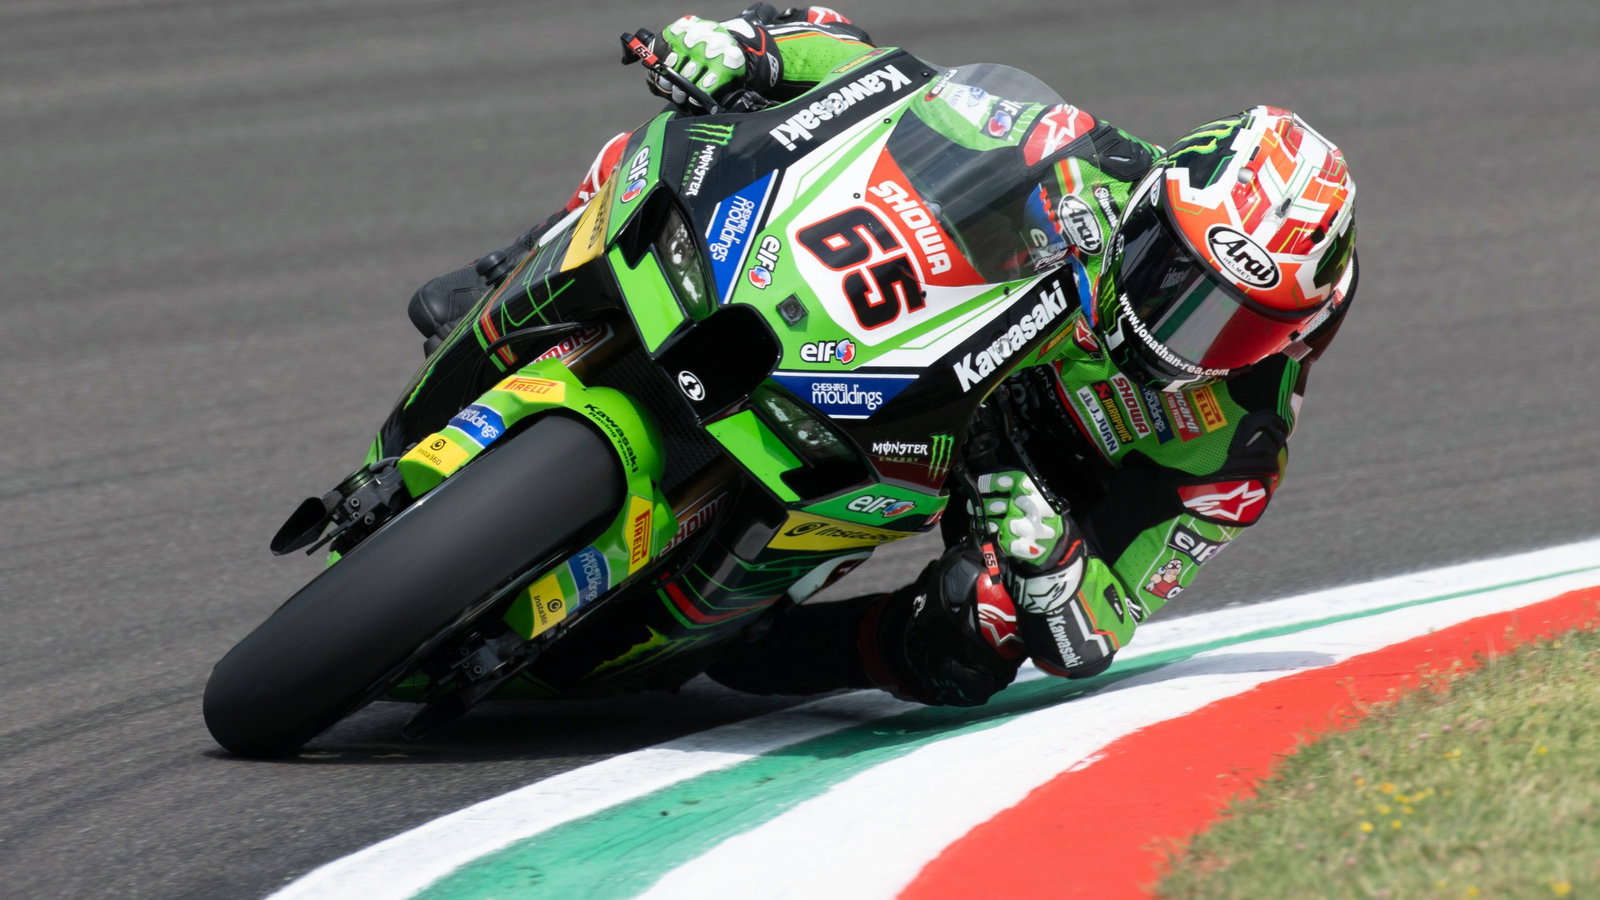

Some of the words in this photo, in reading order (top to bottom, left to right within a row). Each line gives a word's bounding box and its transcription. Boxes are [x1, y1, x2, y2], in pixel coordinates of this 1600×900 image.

[635, 46, 651, 58] 65
[769, 64, 912, 151] Kawasaki
[628, 147, 650, 182] elf
[681, 151, 699, 187] ENERGY
[686, 145, 716, 196] MONSTER
[709, 195, 748, 262] mouldings
[738, 200, 755, 233] CHESHIRE
[868, 180, 952, 275] SHOWA
[1063, 200, 1101, 249] Arai
[756, 235, 781, 272] elf
[795, 206, 927, 331] 65
[1209, 238, 1276, 281] Arai
[800, 342, 835, 363] elf
[953, 280, 1068, 393] Kawasaki
[1119, 293, 1230, 377] www.jonathan-rea.com
[503, 378, 559, 395] PIRELLI
[812, 383, 845, 392] CHESHIRE
[812, 384, 883, 410] mouldings
[1113, 377, 1150, 433] SHOWA
[584, 404, 638, 473] Kawasaki
[588, 412, 617, 438] Racing
[616, 438, 630, 466] Team
[872, 441, 929, 456] MONSTER
[1090, 408, 1118, 452] J.JUAN
[847, 495, 892, 514] elf
[632, 509, 651, 565] PIRELLI
[1174, 531, 1218, 562] elf
[984, 552, 997, 568] 65
[1050, 615, 1084, 668] Kawasaki
